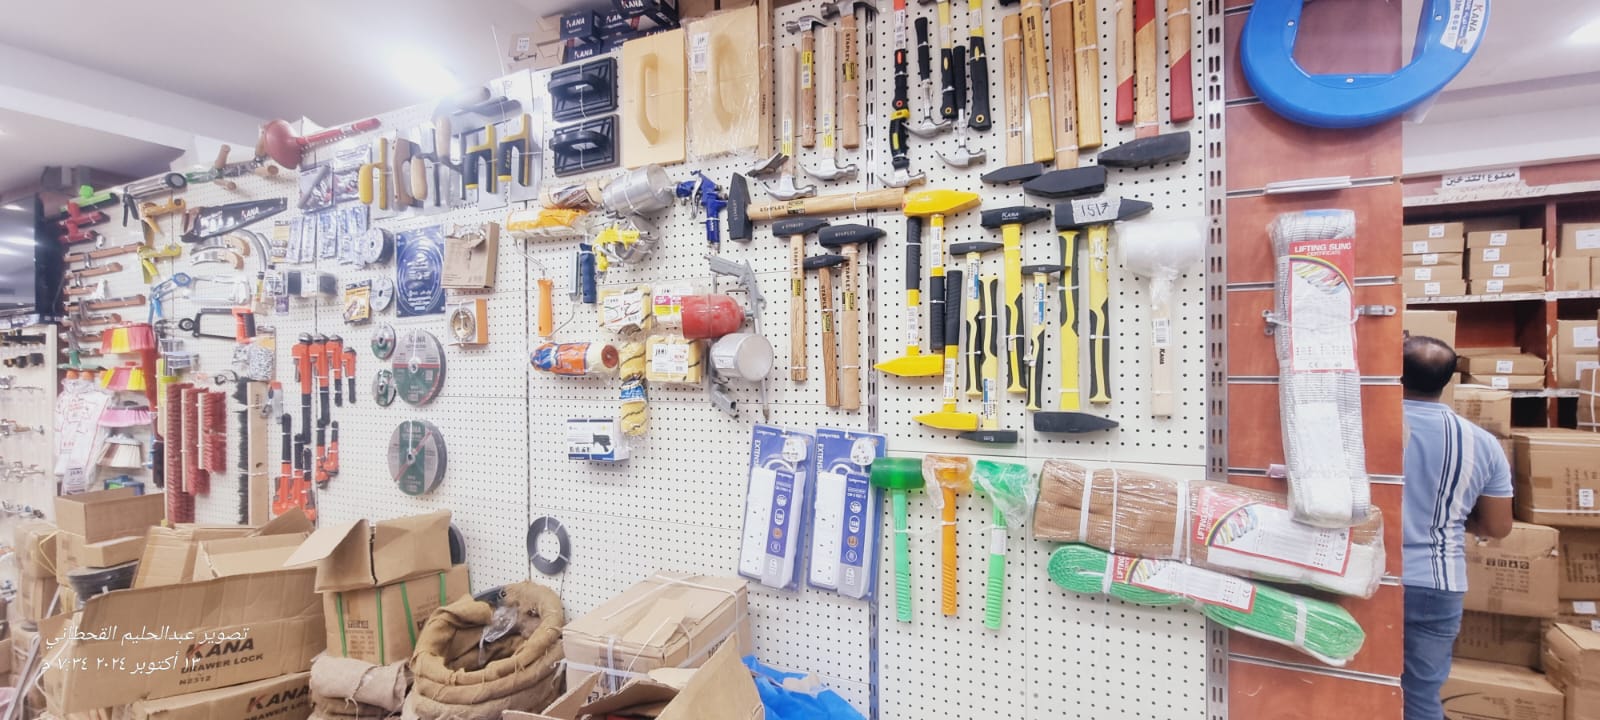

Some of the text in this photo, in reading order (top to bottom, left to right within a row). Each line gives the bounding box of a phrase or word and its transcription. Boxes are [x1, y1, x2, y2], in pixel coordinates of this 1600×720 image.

[566, 17, 585, 28] KANA
[1468, 4, 1484, 32] KANA
[1446, 171, 1516, 186] ممنوع التدخين
[241, 207, 260, 218] KANA
[1294, 242, 1352, 254] LIFTING SLING
[186, 637, 255, 660] KANA
[180, 653, 264, 675] DRAWER LOCK
[246, 684, 311, 713] KANA
